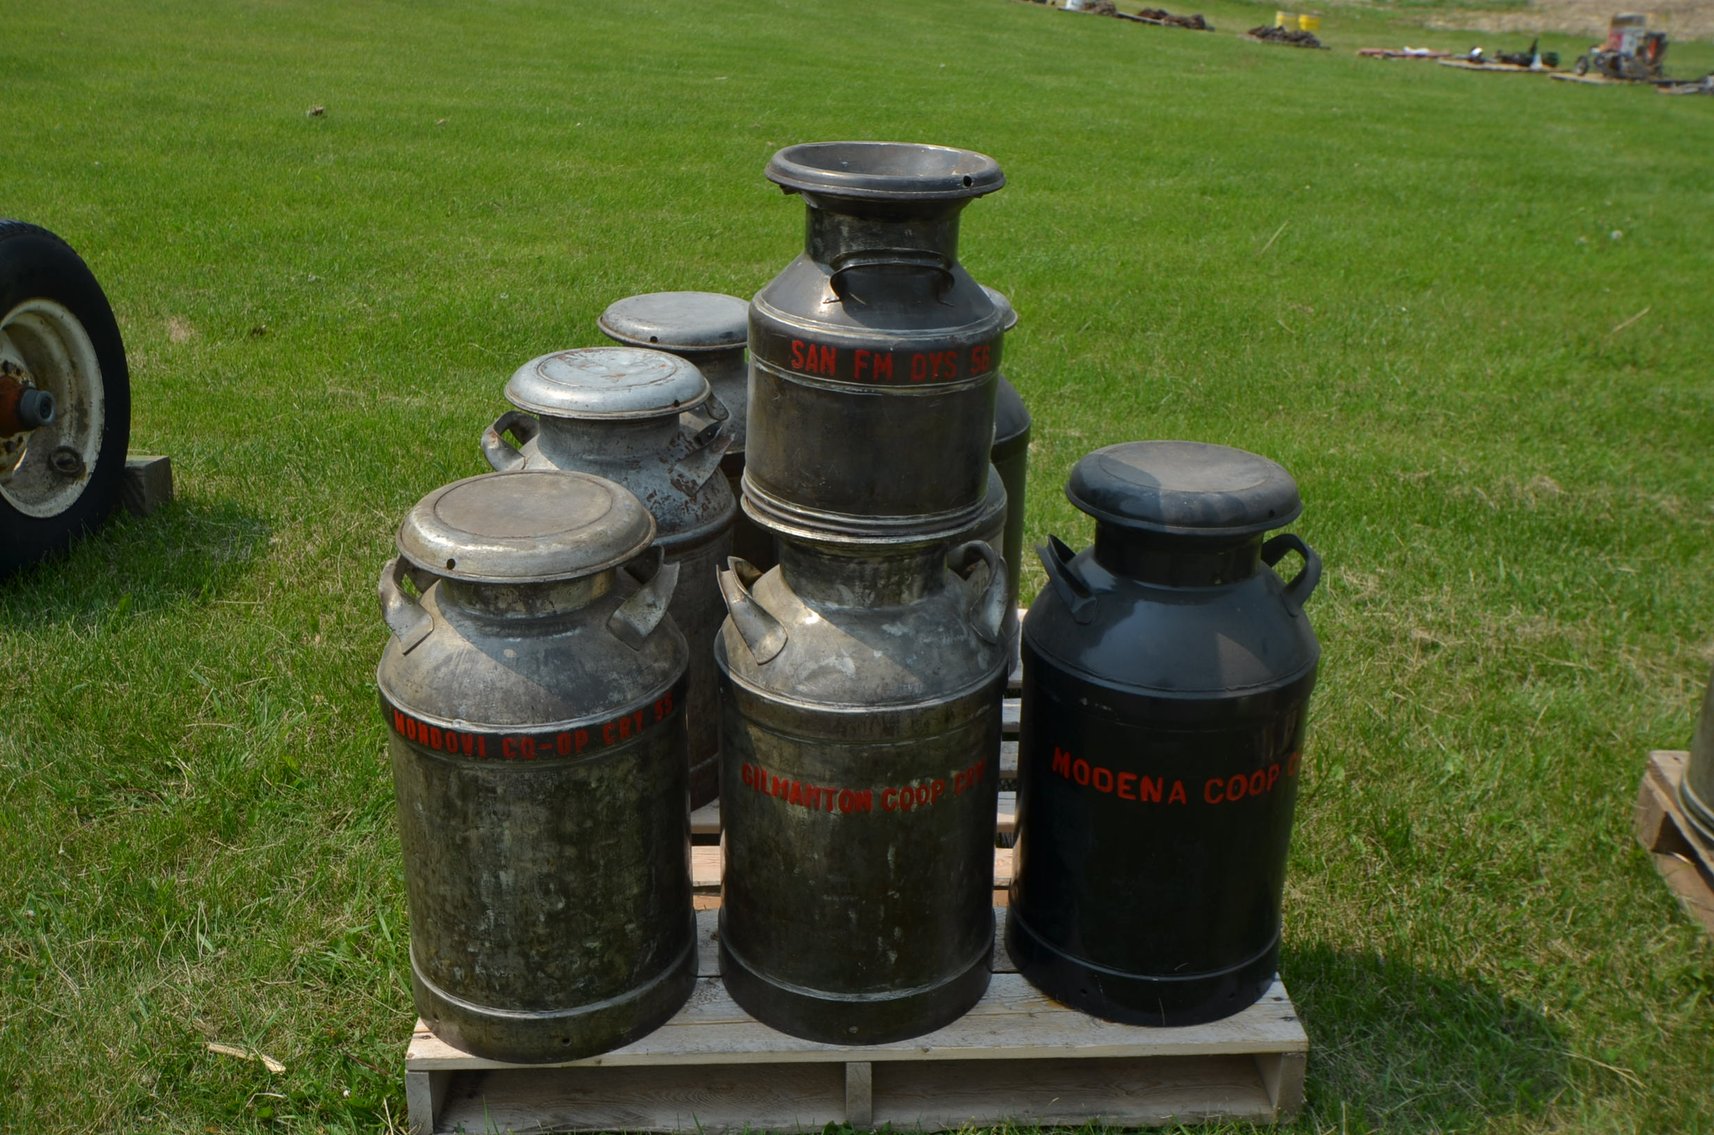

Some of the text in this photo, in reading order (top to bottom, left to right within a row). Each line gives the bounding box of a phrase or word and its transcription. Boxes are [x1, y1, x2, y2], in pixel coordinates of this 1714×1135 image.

[791, 339, 837, 376] SAN
[853, 349, 894, 381] FM
[910, 351, 959, 382] DYS
[394, 709, 487, 758] MONDOVI
[502, 730, 589, 760] CO-OP
[742, 762, 873, 814] GILMANTON
[880, 779, 946, 814] COOP
[1051, 746, 1187, 805] MODENA
[1203, 763, 1281, 804] COOP
